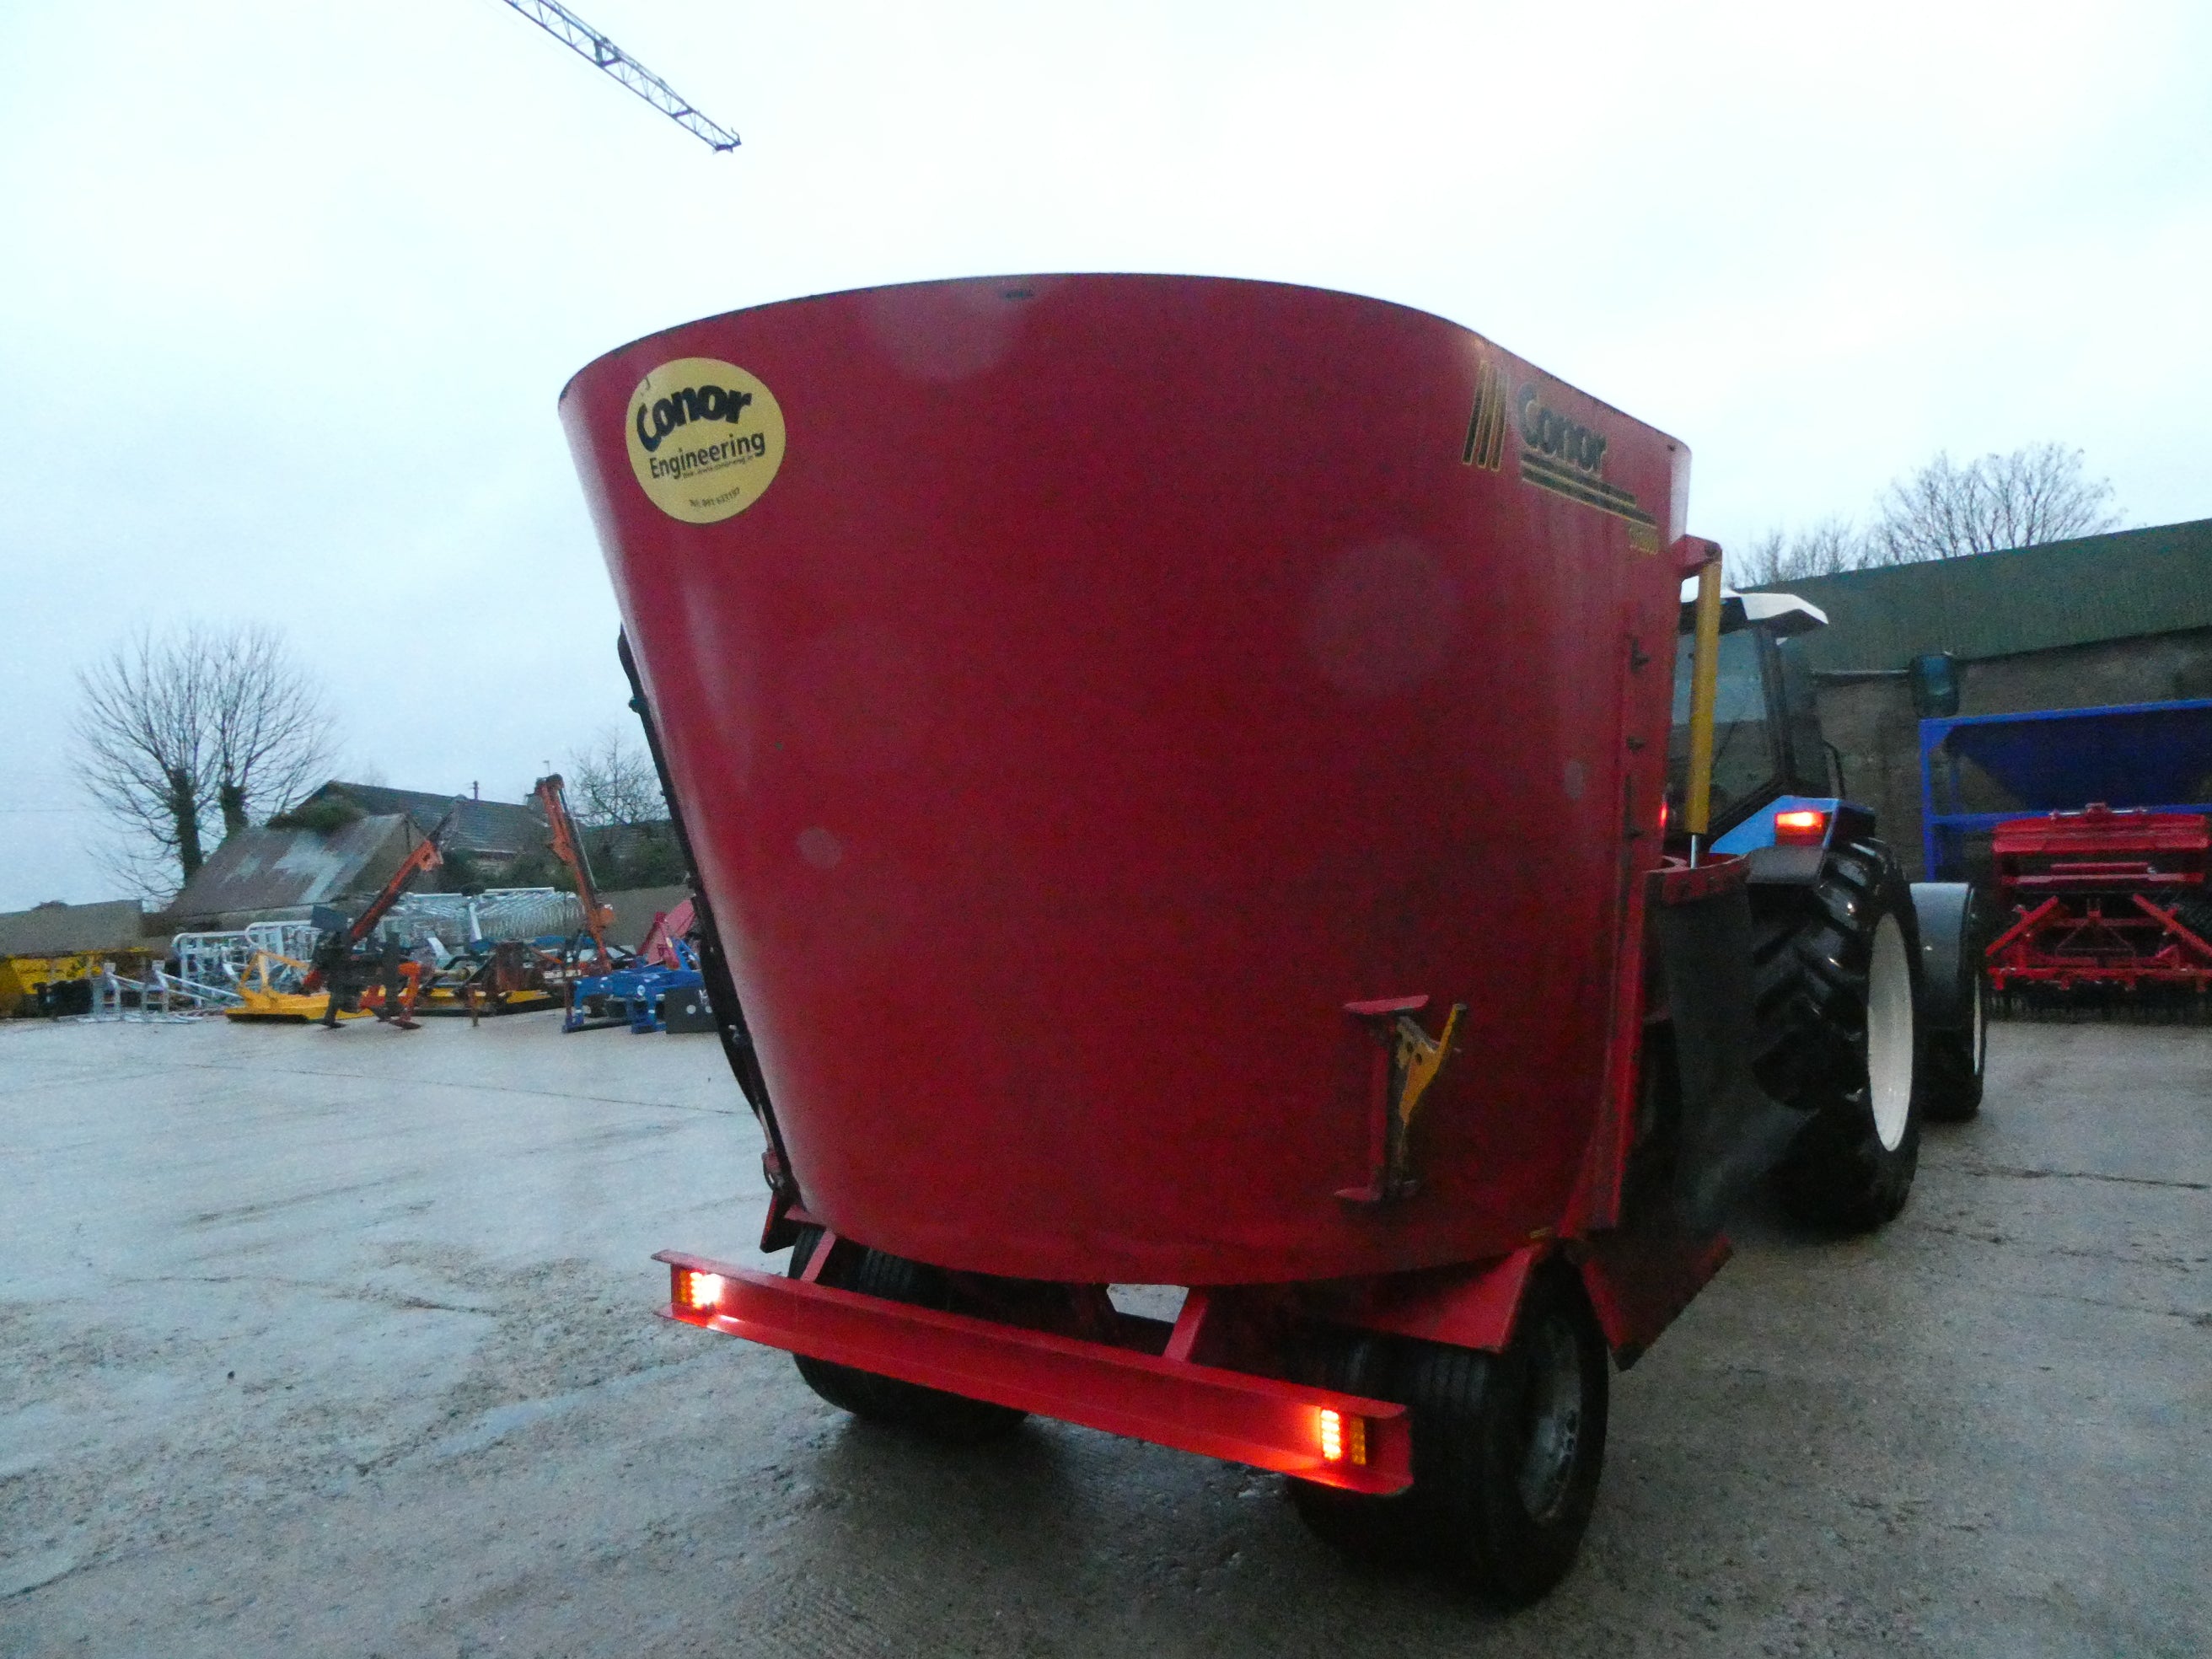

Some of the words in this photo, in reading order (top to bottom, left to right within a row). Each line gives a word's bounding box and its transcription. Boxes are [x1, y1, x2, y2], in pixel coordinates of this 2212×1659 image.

[636, 384, 753, 453] Conor
[1517, 382, 1607, 475] Conor
[649, 432, 765, 480] Engineering
